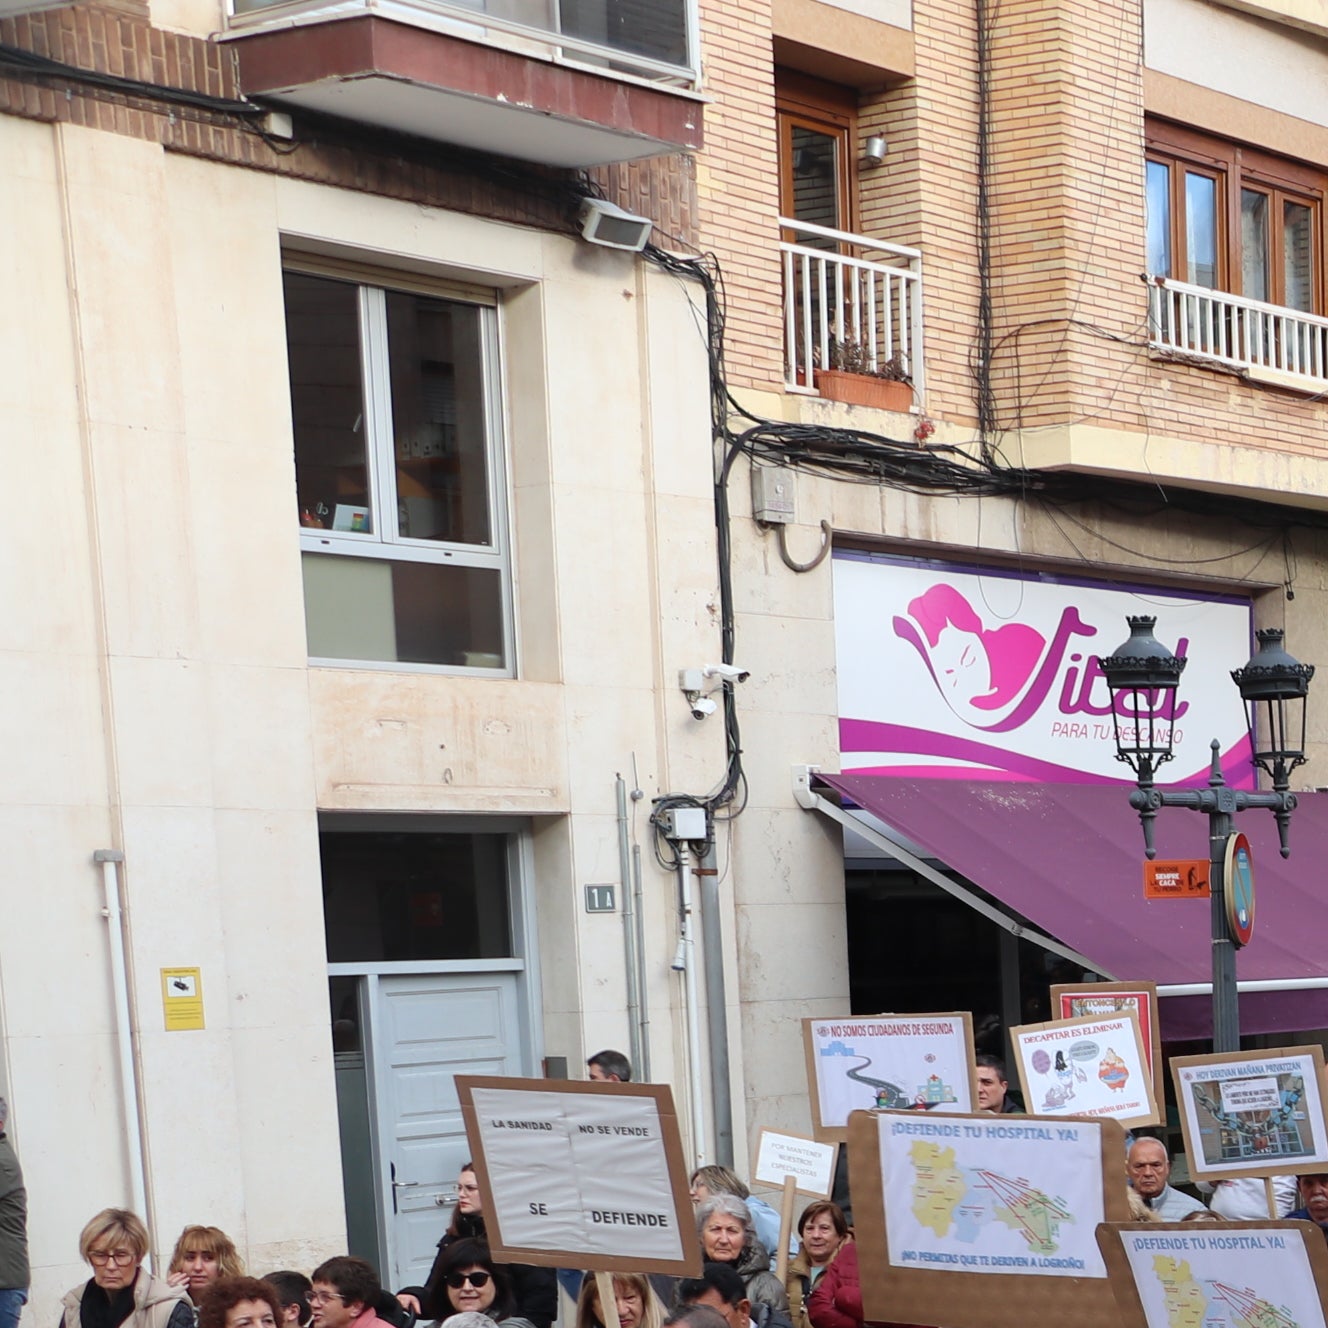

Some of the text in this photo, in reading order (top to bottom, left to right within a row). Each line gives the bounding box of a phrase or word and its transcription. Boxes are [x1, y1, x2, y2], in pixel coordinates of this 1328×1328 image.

[1051, 721, 1183, 744] PARA TU DESCANSO
[831, 1023, 953, 1037] NO SOMOS CIUDADANOS DE SEGUNDA
[1024, 1023, 1123, 1044] DECAPITAR ELIMINAR
[1196, 1062, 1301, 1079] HOY DERIVAN MAÑANA PRIVATIZAN
[492, 1120, 648, 1137] LA SANIDAD NO SE VENDE
[892, 1122, 1078, 1141] ¡DEFIENDE TU HOSPITAL YA!
[529, 1203, 668, 1227] SE DEFIENDE
[1134, 1237, 1285, 1251] ¡DEFIENDE TU HOSPITAL YA!
[901, 1251, 1084, 1269] ¡NO PERMITAS QUE TE DERIVEN LOGROÑO!
